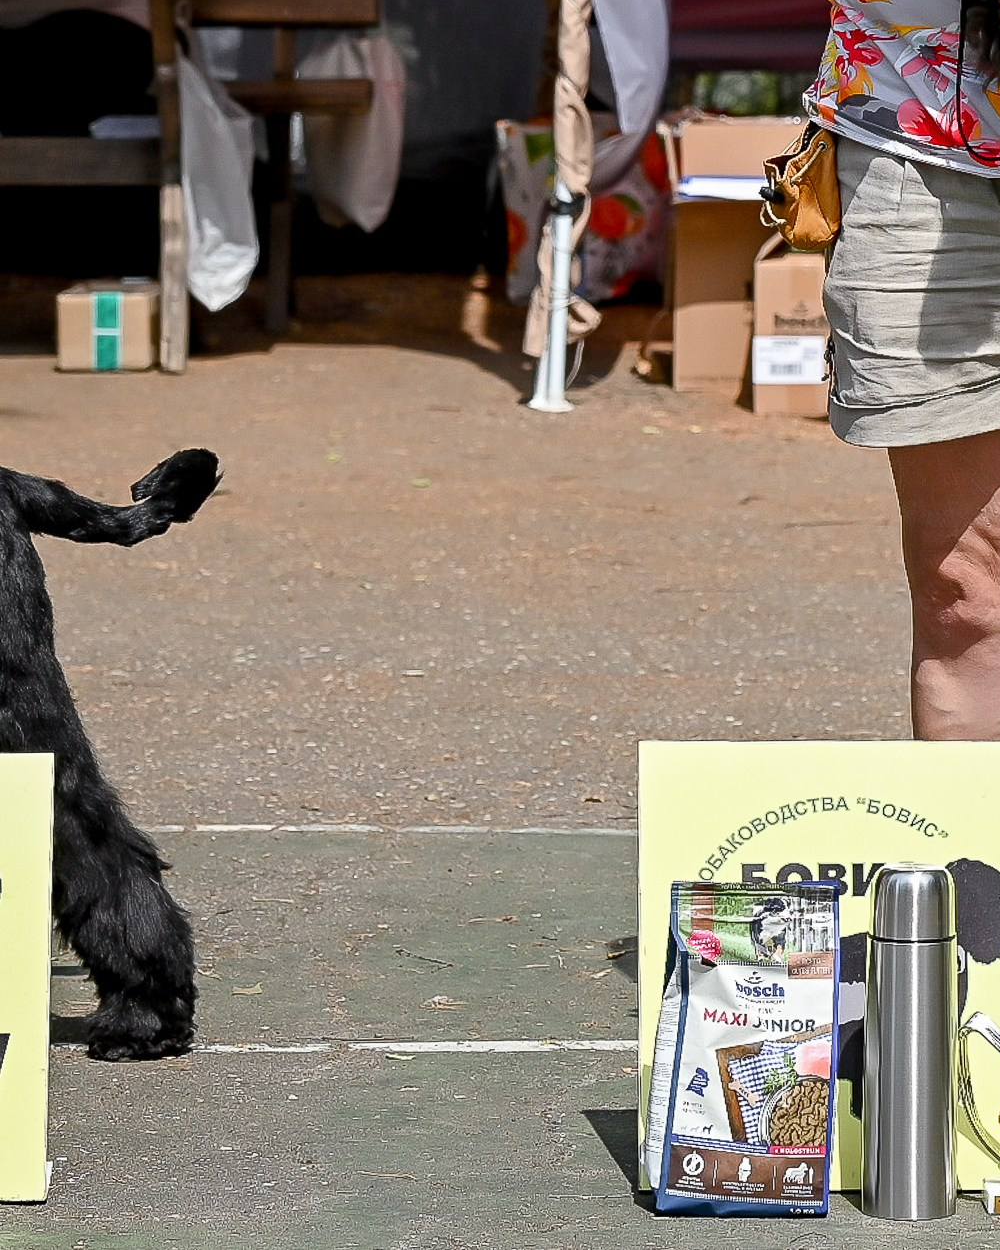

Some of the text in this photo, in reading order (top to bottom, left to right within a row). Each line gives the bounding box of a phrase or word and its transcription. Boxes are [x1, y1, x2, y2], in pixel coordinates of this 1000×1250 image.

[697, 795, 850, 881] ОБАКОВОДСТВА
[741, 861, 887, 897] БОВИ
[734, 980, 785, 997] bosch
[703, 1007, 748, 1027] MAXI
